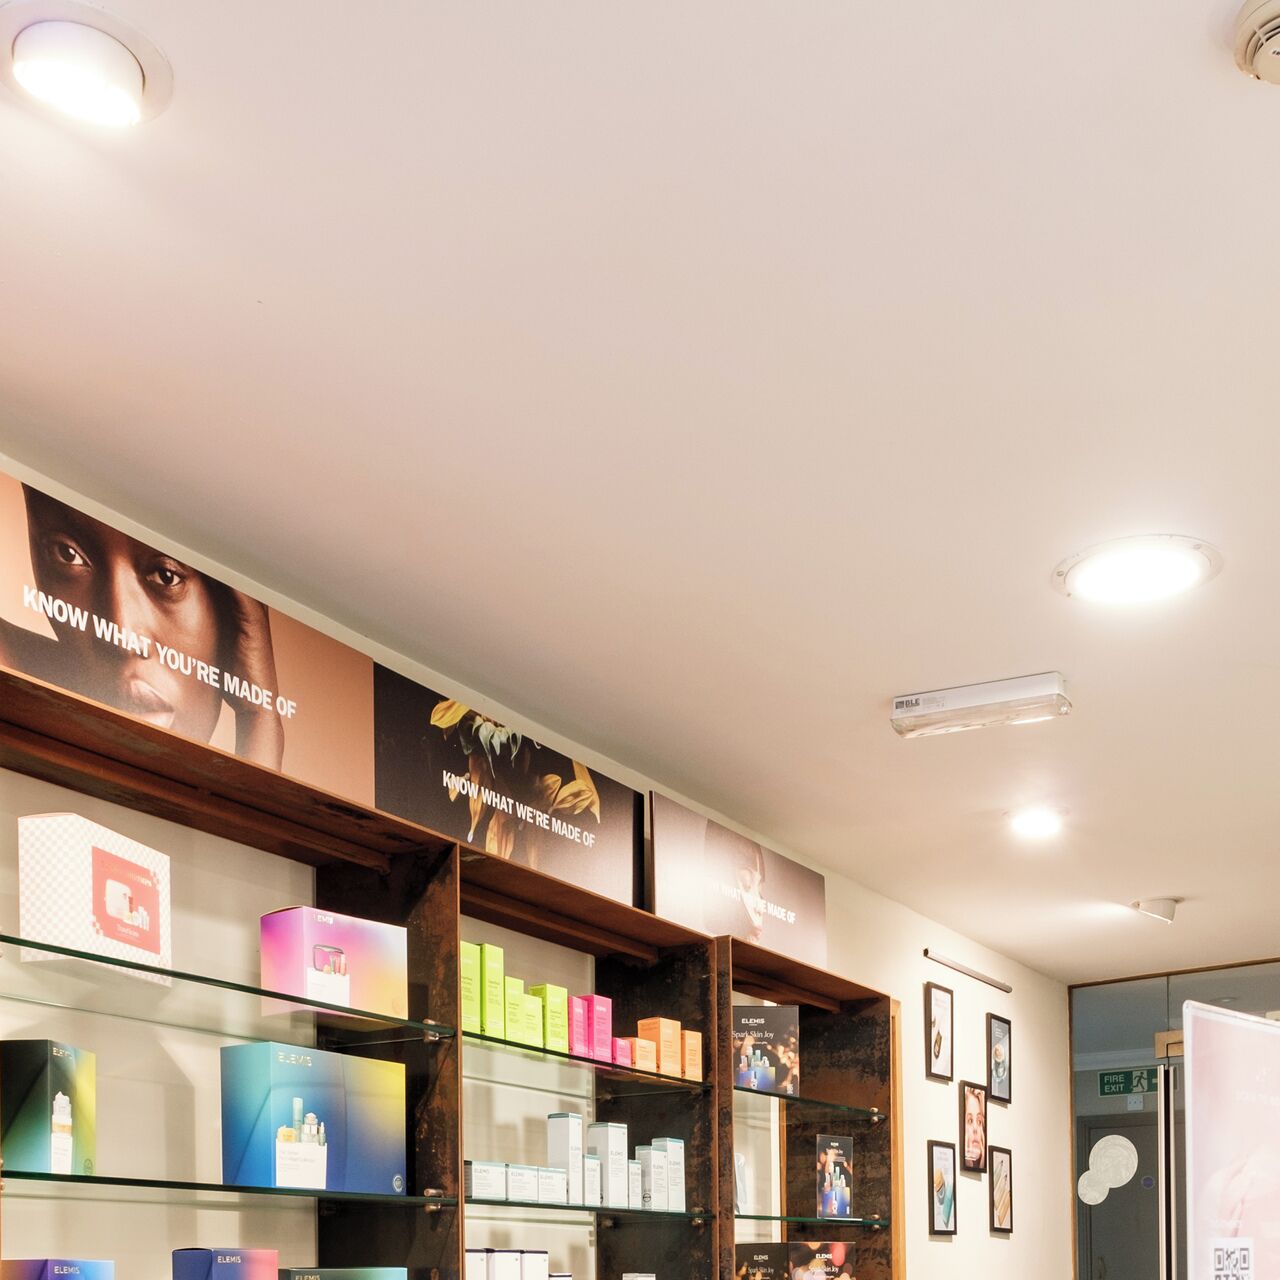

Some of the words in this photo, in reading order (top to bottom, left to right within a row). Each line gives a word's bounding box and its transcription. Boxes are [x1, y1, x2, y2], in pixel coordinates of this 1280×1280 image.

[22, 585, 88, 633] KNOW
[92, 617, 152, 661] WHAT
[155, 642, 220, 690] YOU'RE
[223, 671, 274, 712] MADE
[276, 695, 297, 720] OF
[442, 770, 480, 799] KNOW
[481, 786, 514, 816] WHAT
[516, 802, 550, 832] WE'RE
[551, 816, 581, 845] MADE
[583, 831, 596, 849] OF
[1104, 1074, 1125, 1083] FIRE
[1104, 1084, 1125, 1093] EXIT
[217, 1256, 241, 1264] ELEMIS
[54, 1266, 80, 1274] ELEMIS
